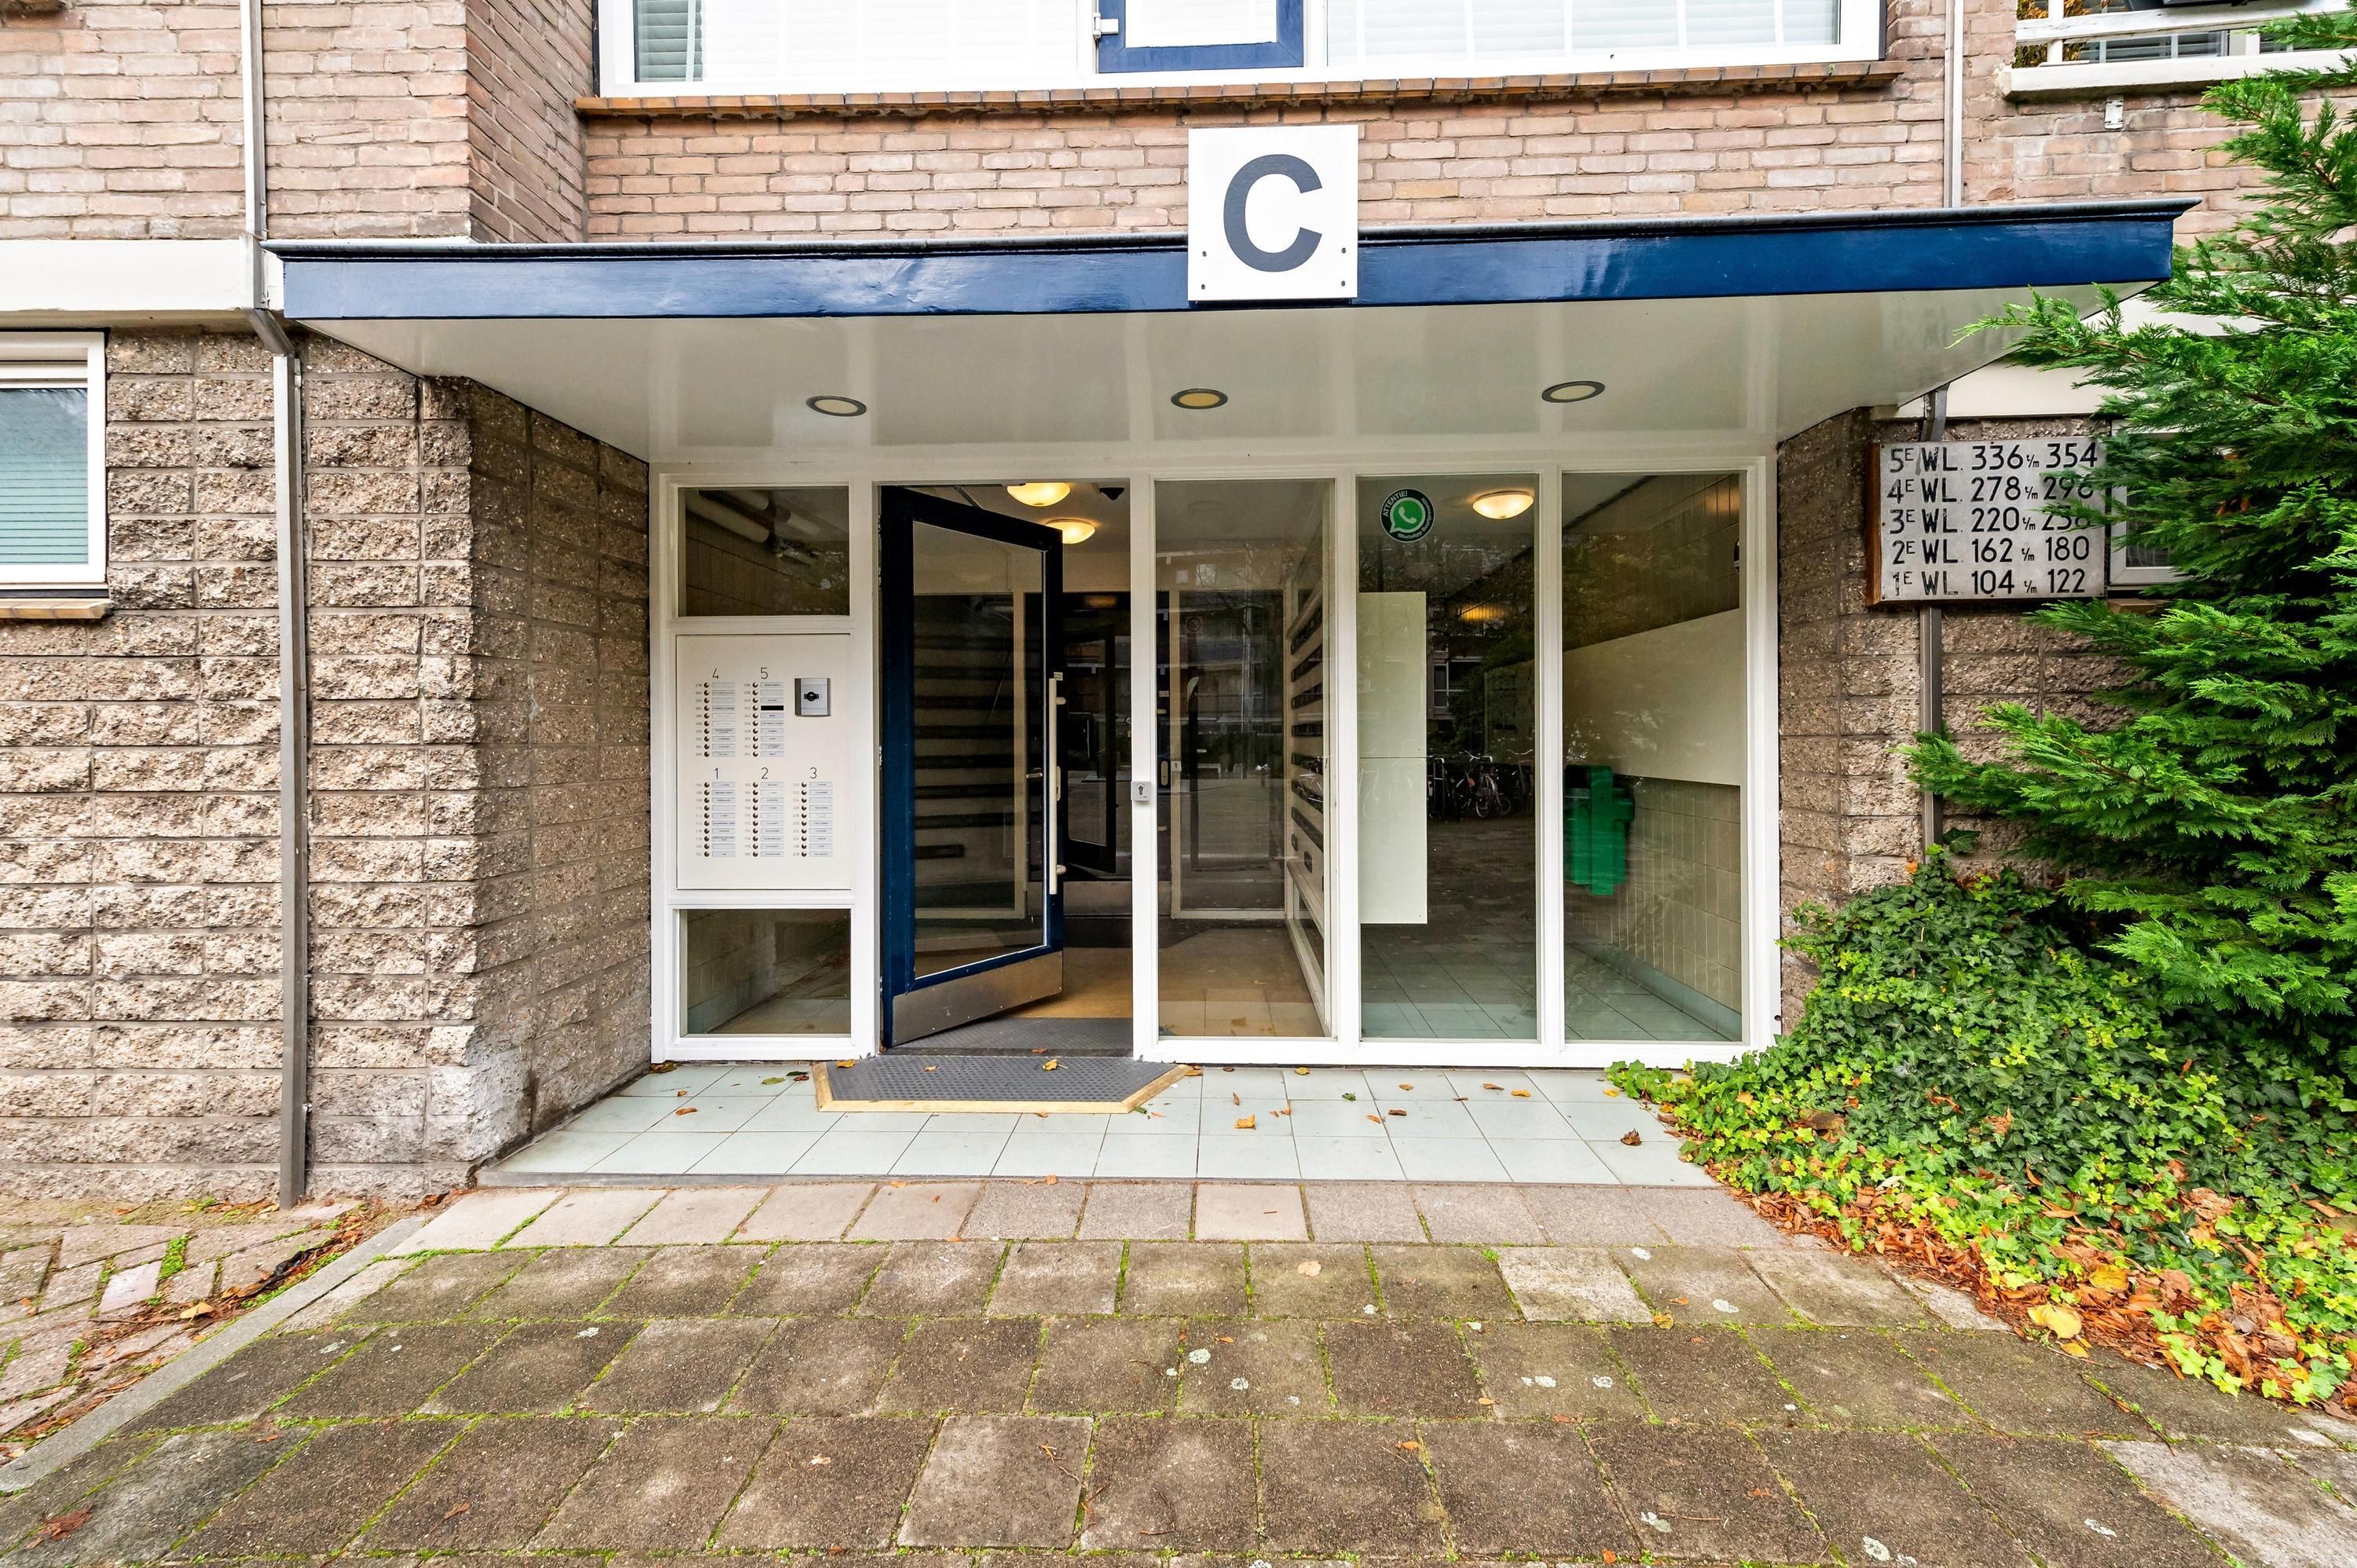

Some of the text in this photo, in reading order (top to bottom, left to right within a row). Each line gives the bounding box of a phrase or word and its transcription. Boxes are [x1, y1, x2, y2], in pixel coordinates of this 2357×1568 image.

[1223, 154, 1323, 273] C
[1921, 446, 1963, 471] WL.
[1971, 445, 2023, 470] 336
[2046, 442, 2098, 468] 354
[1920, 478, 1963, 503] WL.
[1970, 476, 2021, 502] 278
[1383, 490, 1408, 517] ATTENTIE!
[1921, 508, 1963, 533] WL.
[1970, 507, 2019, 532] 220
[1971, 537, 2013, 562] 162
[2045, 536, 2090, 561] 180
[1971, 570, 2014, 595] 104
[2047, 568, 2085, 593] 122
[712, 667, 720, 680] 4
[760, 667, 768, 680] 5
[714, 768, 719, 779] 1
[761, 767, 768, 779] 2
[809, 767, 817, 779] 3
